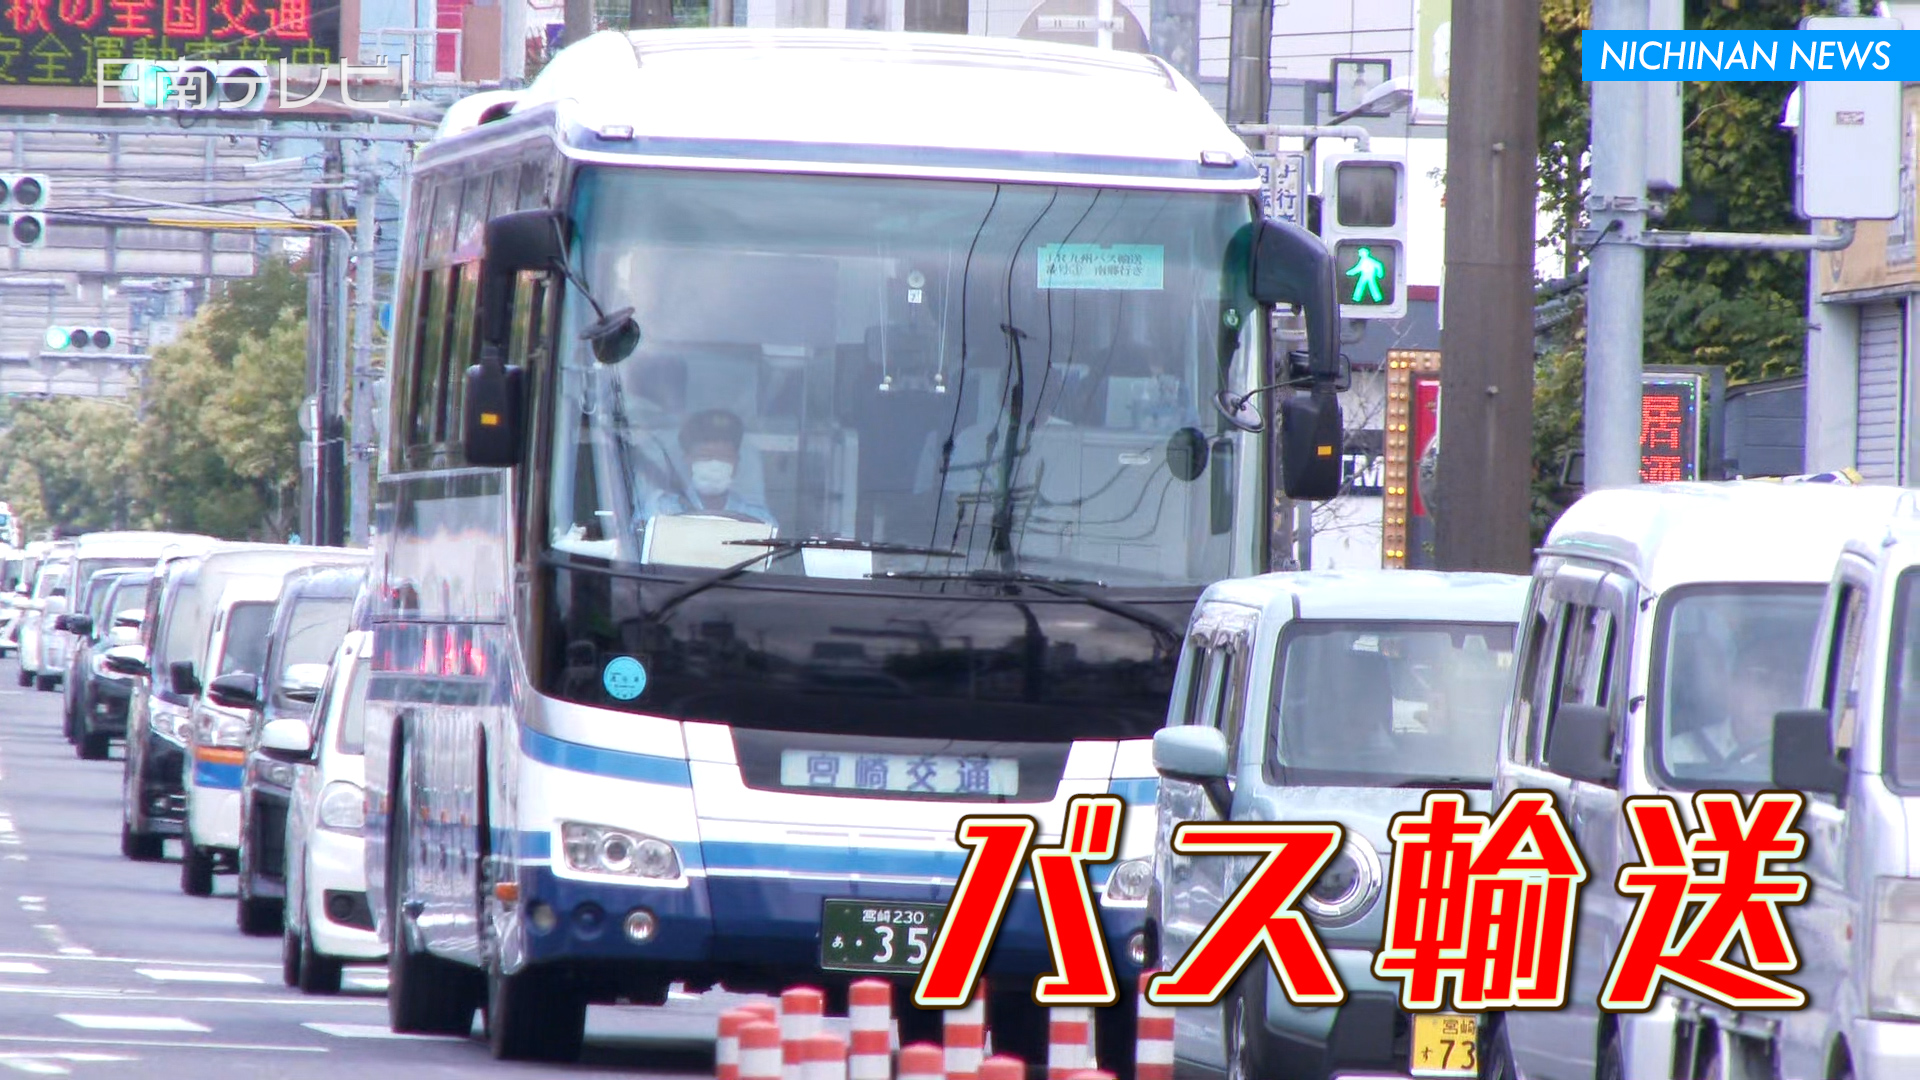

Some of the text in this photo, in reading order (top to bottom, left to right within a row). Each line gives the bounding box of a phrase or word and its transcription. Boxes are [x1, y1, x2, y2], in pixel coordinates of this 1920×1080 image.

[5, 0, 312, 40] 秋の全国交通
[806, 753, 990, 795] 宮崎交通
